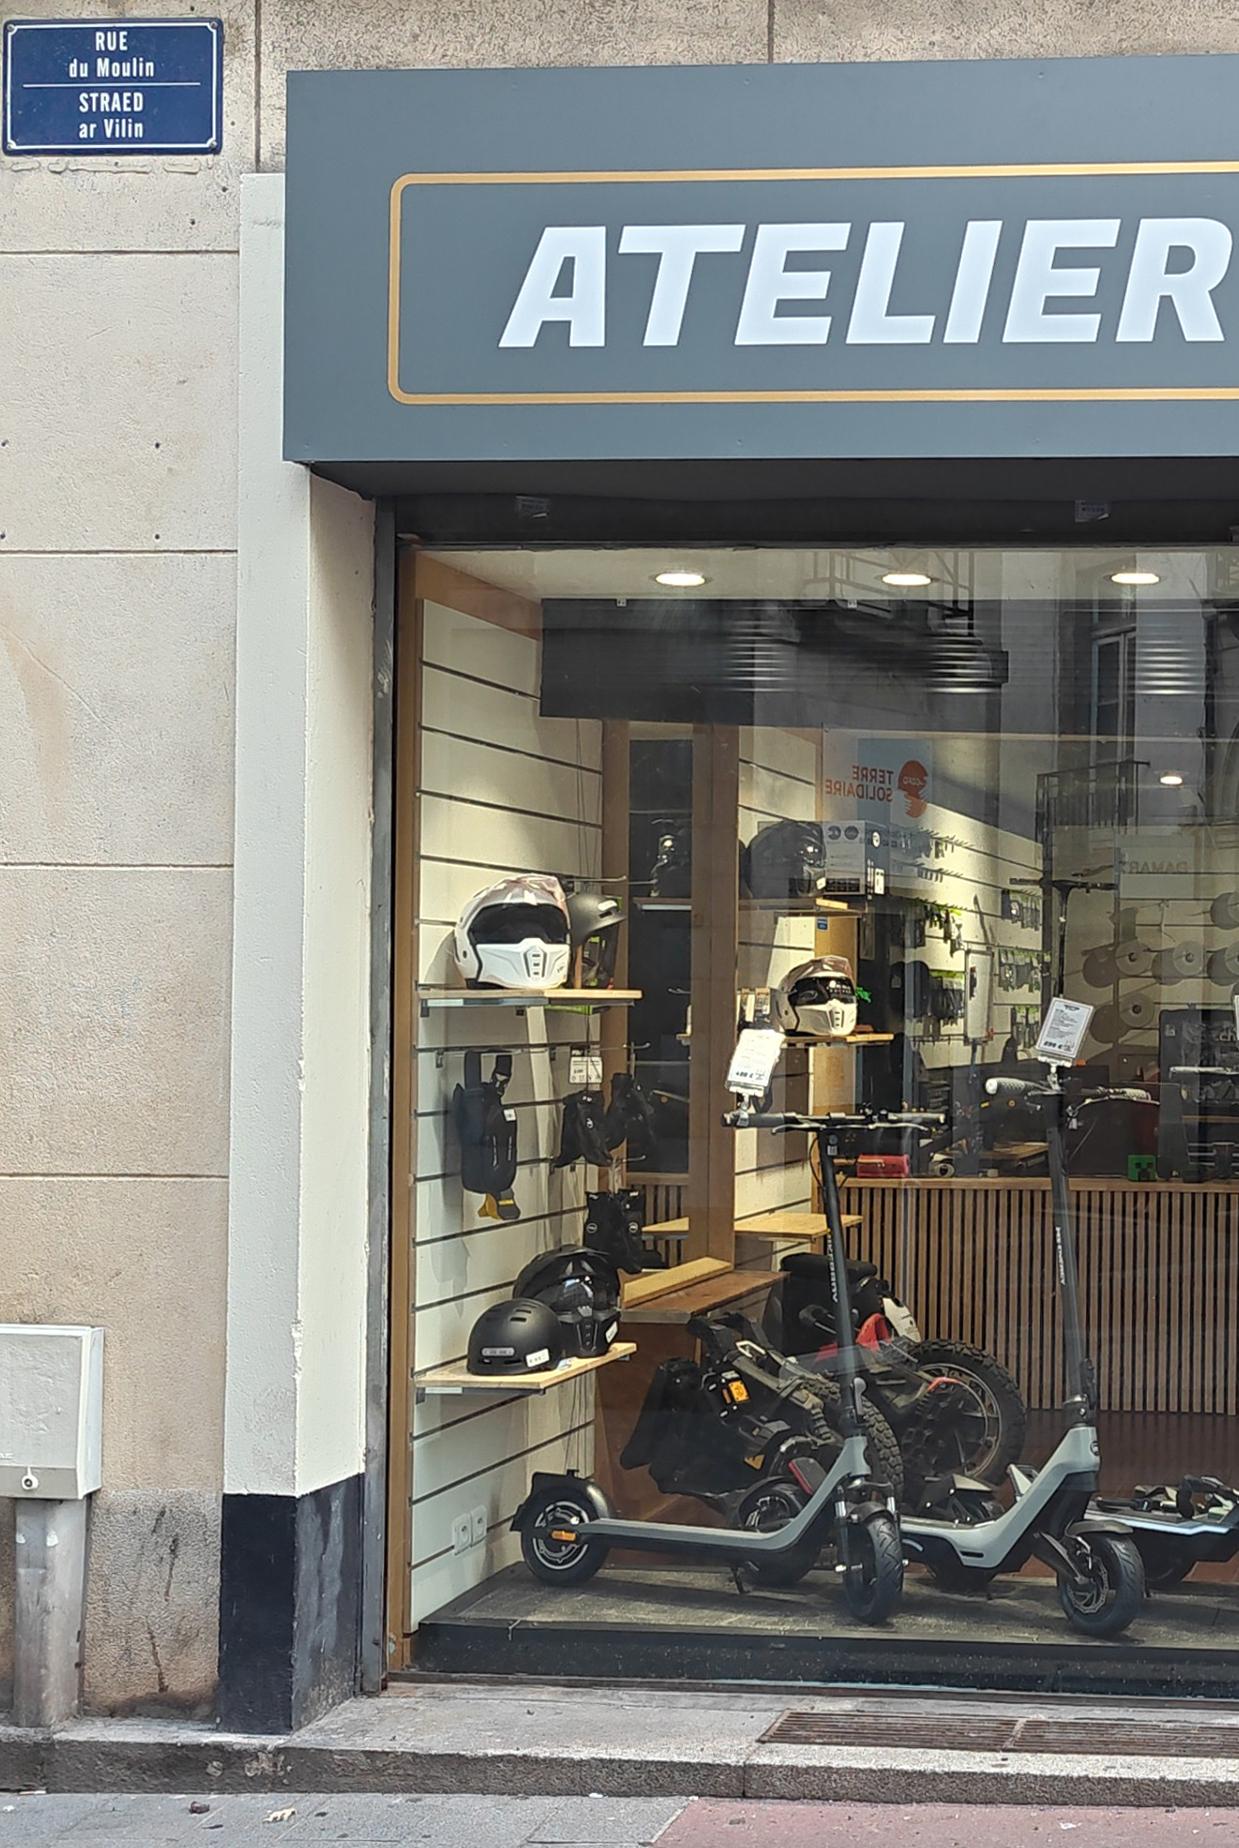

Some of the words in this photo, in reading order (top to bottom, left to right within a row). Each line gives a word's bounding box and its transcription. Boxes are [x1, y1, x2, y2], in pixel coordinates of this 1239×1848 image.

[95, 31, 128, 51] RUE
[69, 58, 89, 78] du
[96, 57, 154, 78] Moulin
[79, 91, 144, 113] STRAED
[78, 123, 97, 139] ar
[103, 118, 143, 139] Vilin
[499, 218, 1232, 347] ATELIER
